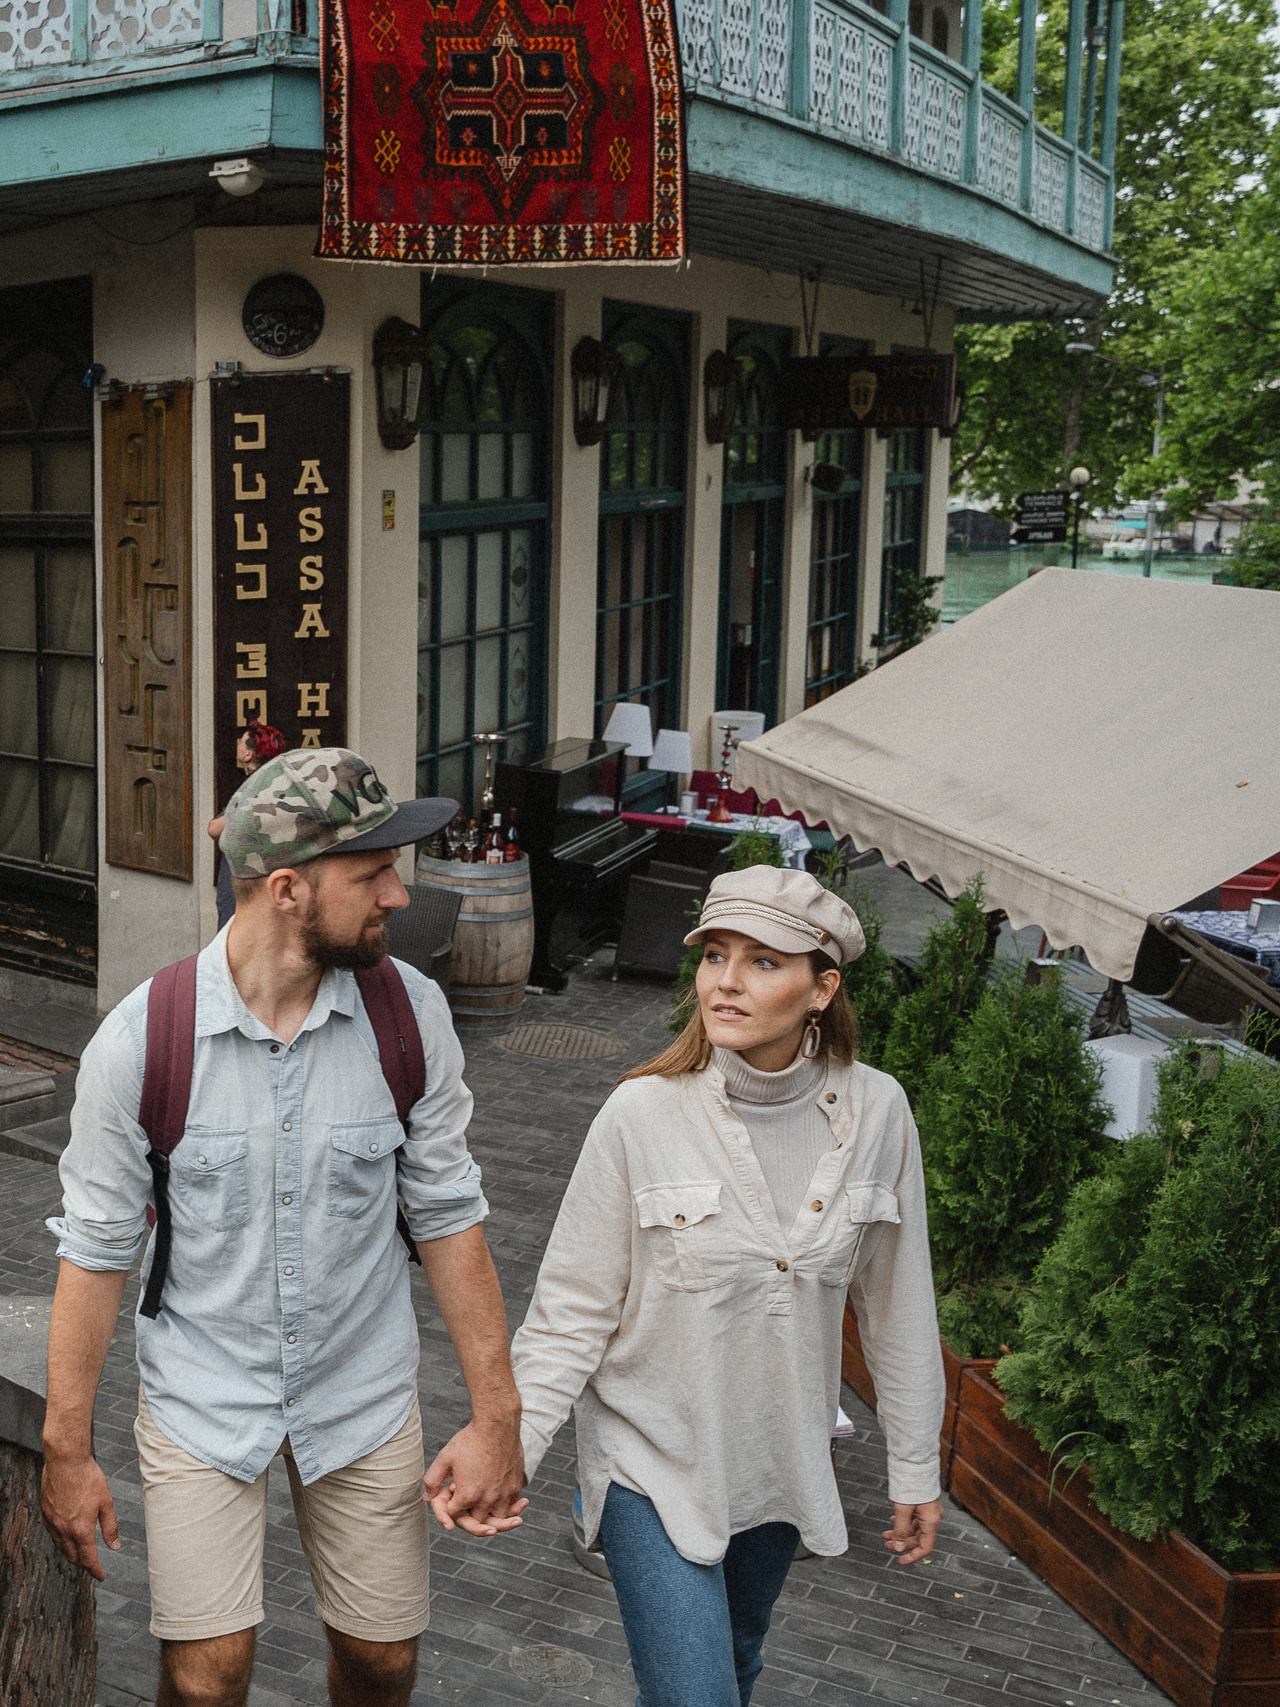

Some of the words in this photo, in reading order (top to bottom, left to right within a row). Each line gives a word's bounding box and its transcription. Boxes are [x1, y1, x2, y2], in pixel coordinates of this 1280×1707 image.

[875, 405, 931, 423] HALL
[233, 412, 268, 600] ასსა
[293, 460, 330, 639] ASSA
